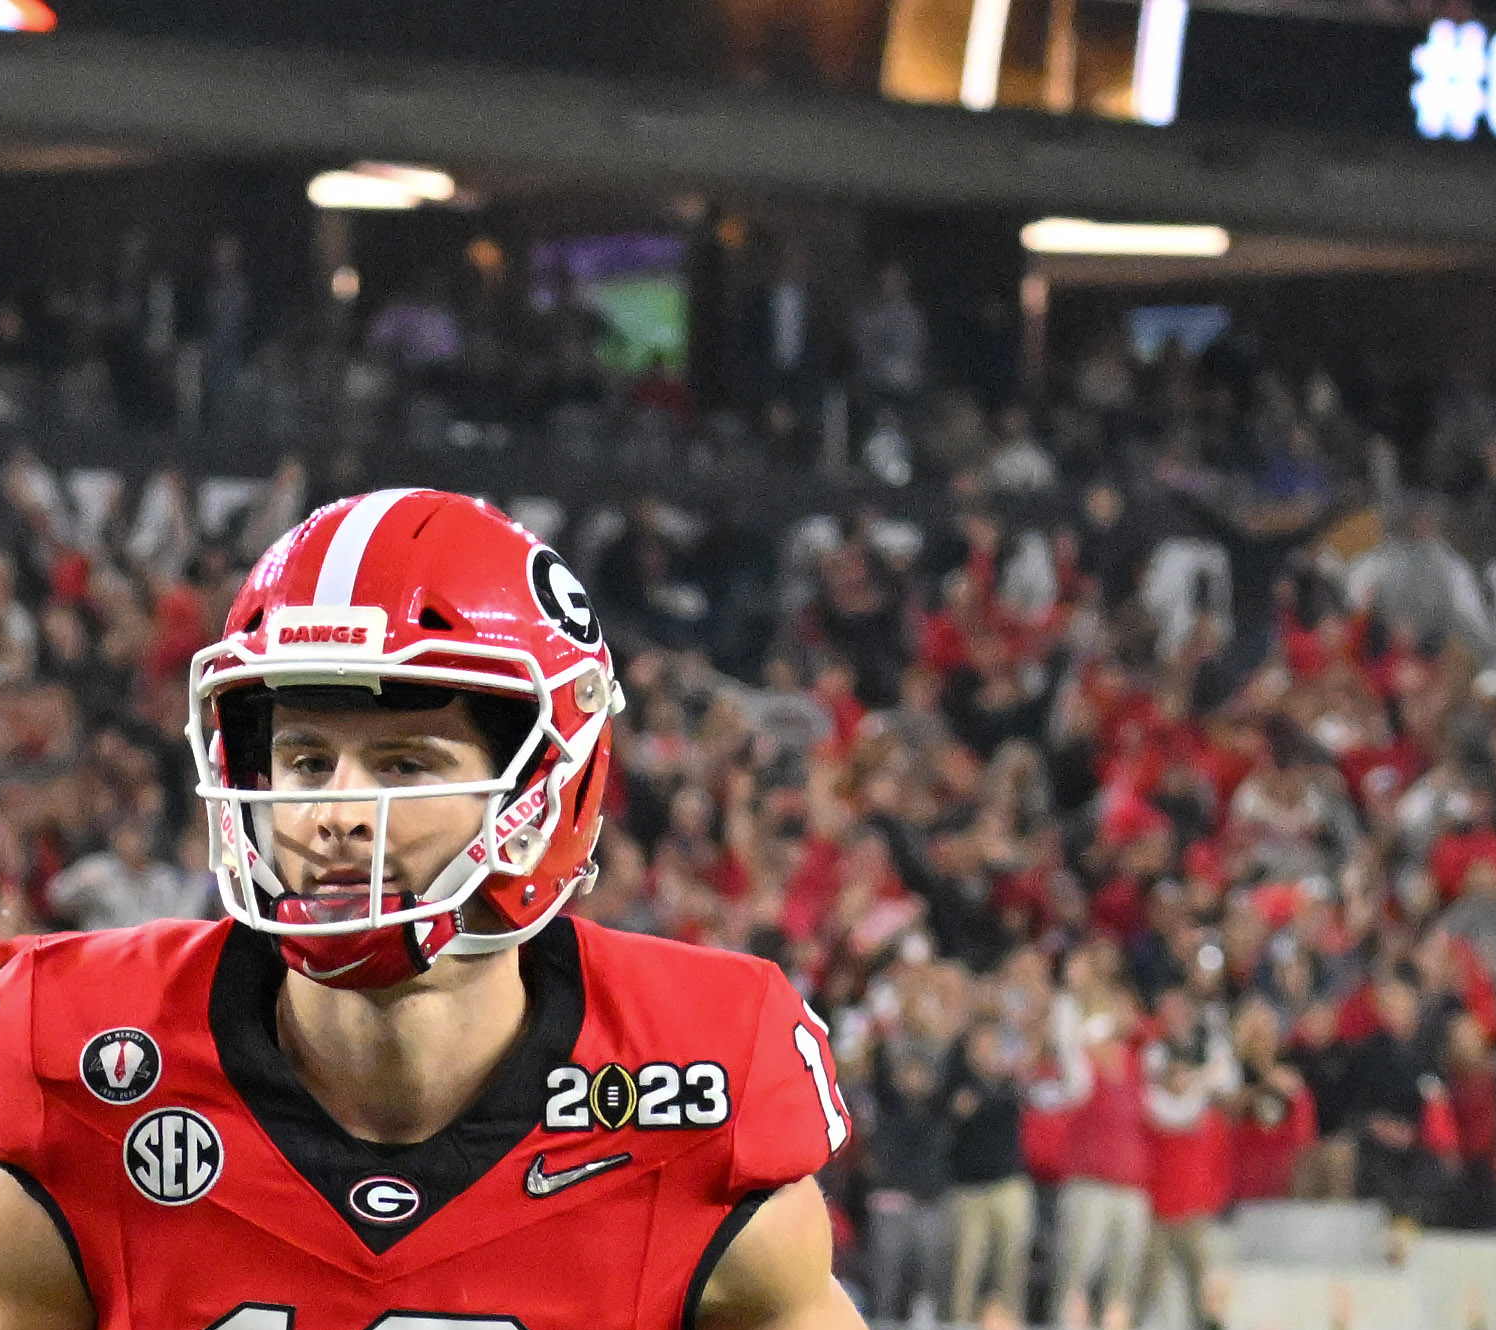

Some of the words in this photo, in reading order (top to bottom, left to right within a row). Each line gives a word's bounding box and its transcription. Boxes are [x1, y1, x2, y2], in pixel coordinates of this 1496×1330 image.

[278, 625, 369, 645] DAWGS
[544, 1061, 731, 1130] 2023
[132, 1117, 219, 1196] SEC
